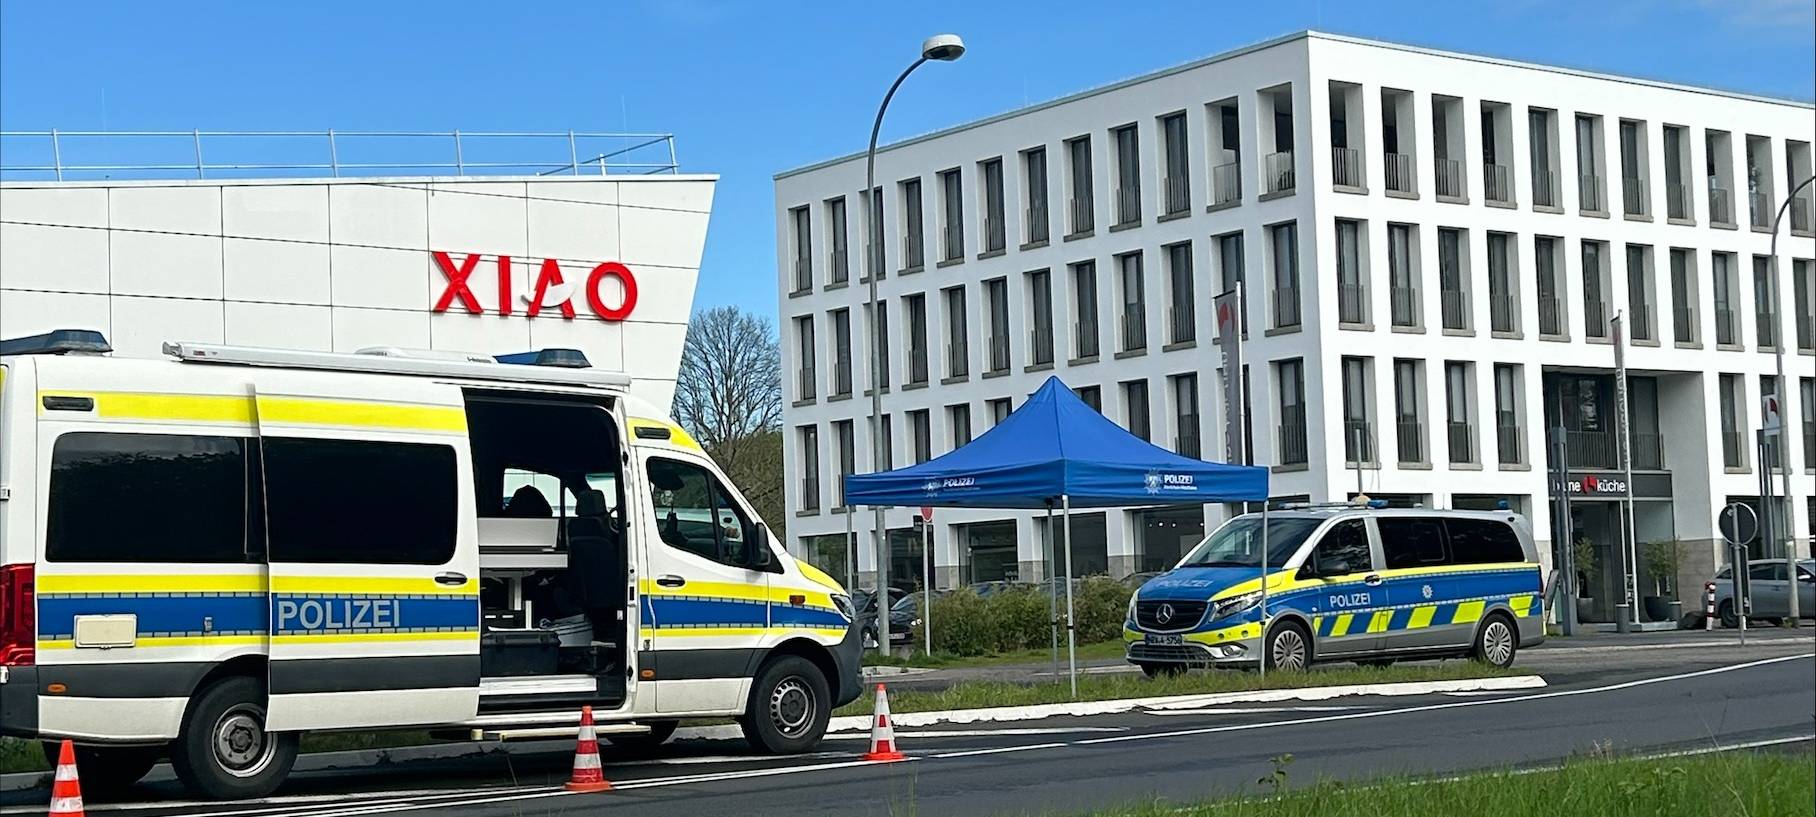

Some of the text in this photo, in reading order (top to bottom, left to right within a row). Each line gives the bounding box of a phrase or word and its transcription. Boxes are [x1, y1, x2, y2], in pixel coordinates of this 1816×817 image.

[432, 251, 638, 322] XIAO
[943, 478, 975, 488] POLIZEI
[1164, 475, 1193, 484] POLIZEI
[1597, 479, 1626, 492] küche
[1330, 592, 1371, 608] POLIZEI
[278, 600, 400, 629] POLIZEI
